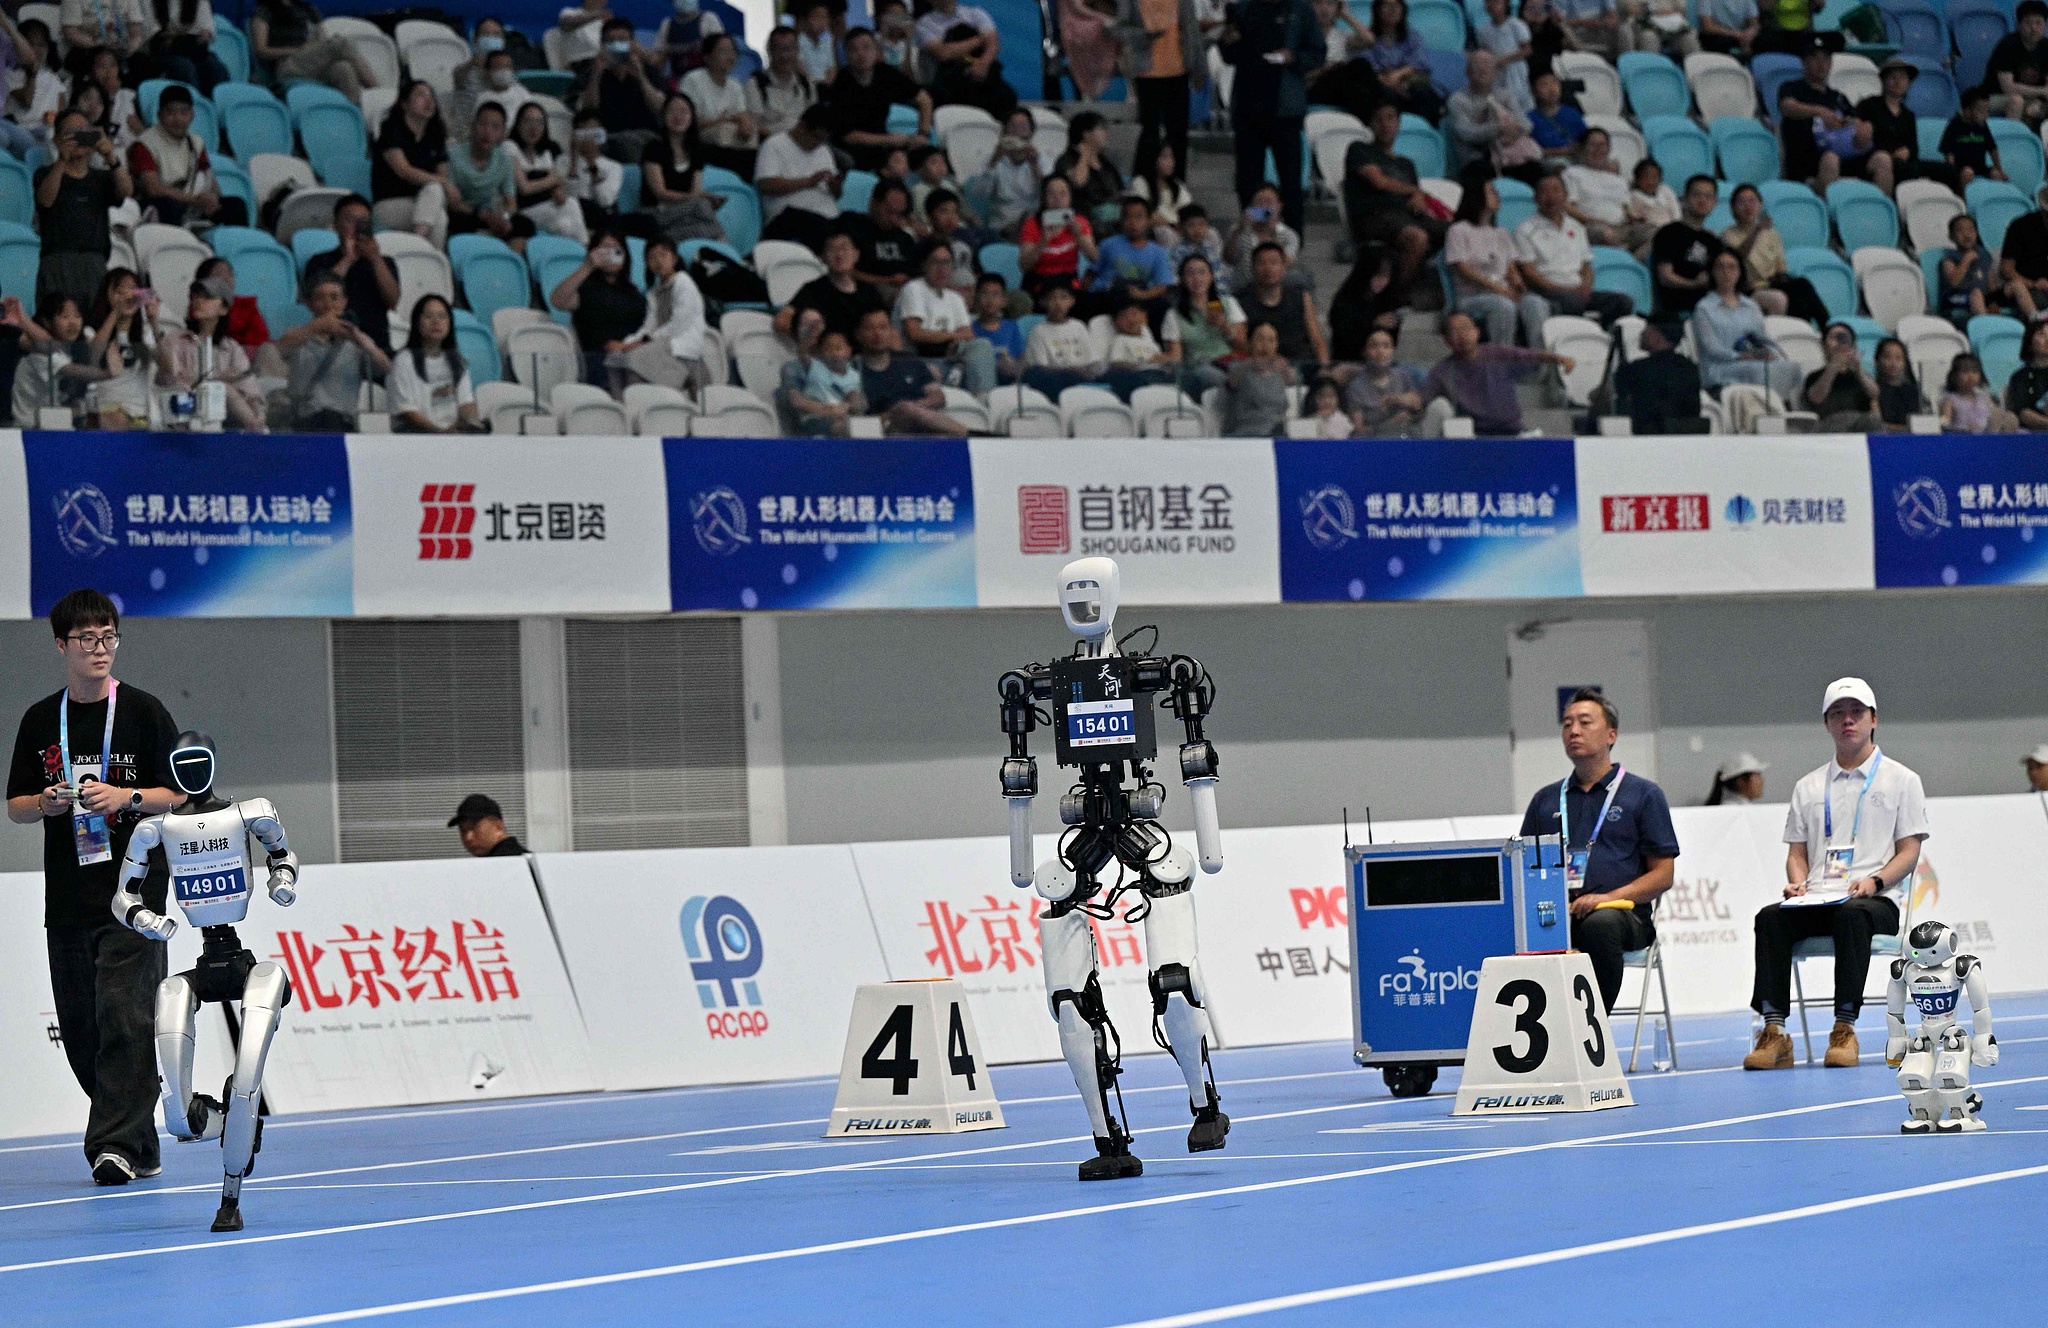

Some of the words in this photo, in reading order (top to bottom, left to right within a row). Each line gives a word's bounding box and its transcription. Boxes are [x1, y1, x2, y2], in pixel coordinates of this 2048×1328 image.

[126, 495, 332, 524] 世界人形机器人运动会
[758, 495, 955, 522] 世界人形机器人运动会
[1078, 484, 1233, 531] 首钢基金
[1365, 492, 1555, 518] 世界人形机器人运动会
[1610, 498, 1702, 531] 新京报
[1763, 498, 1846, 525] 贝壳财经
[485, 501, 605, 540] 北京国资
[1366, 524, 1387, 539] The
[1389, 524, 1423, 538] World
[127, 530, 150, 546] The
[152, 530, 189, 546] World
[760, 529, 782, 544] The
[783, 529, 818, 544] World
[1081, 536, 1181, 555] SHOUGANG
[1187, 535, 1236, 554] FUND
[1077, 716, 1128, 734] 15401
[180, 838, 229, 856] 汪星人科技
[181, 874, 236, 895] 14901
[1658, 878, 1731, 922] 进化
[269, 918, 520, 1013] 北京经信
[1393, 992, 1436, 1006] 菲普莱
[706, 1010, 769, 1040] RCAP
[1492, 978, 1549, 1074] 3
[1573, 973, 1605, 1068] 3
[861, 1004, 918, 1096] 4
[948, 1002, 976, 1091] 4
